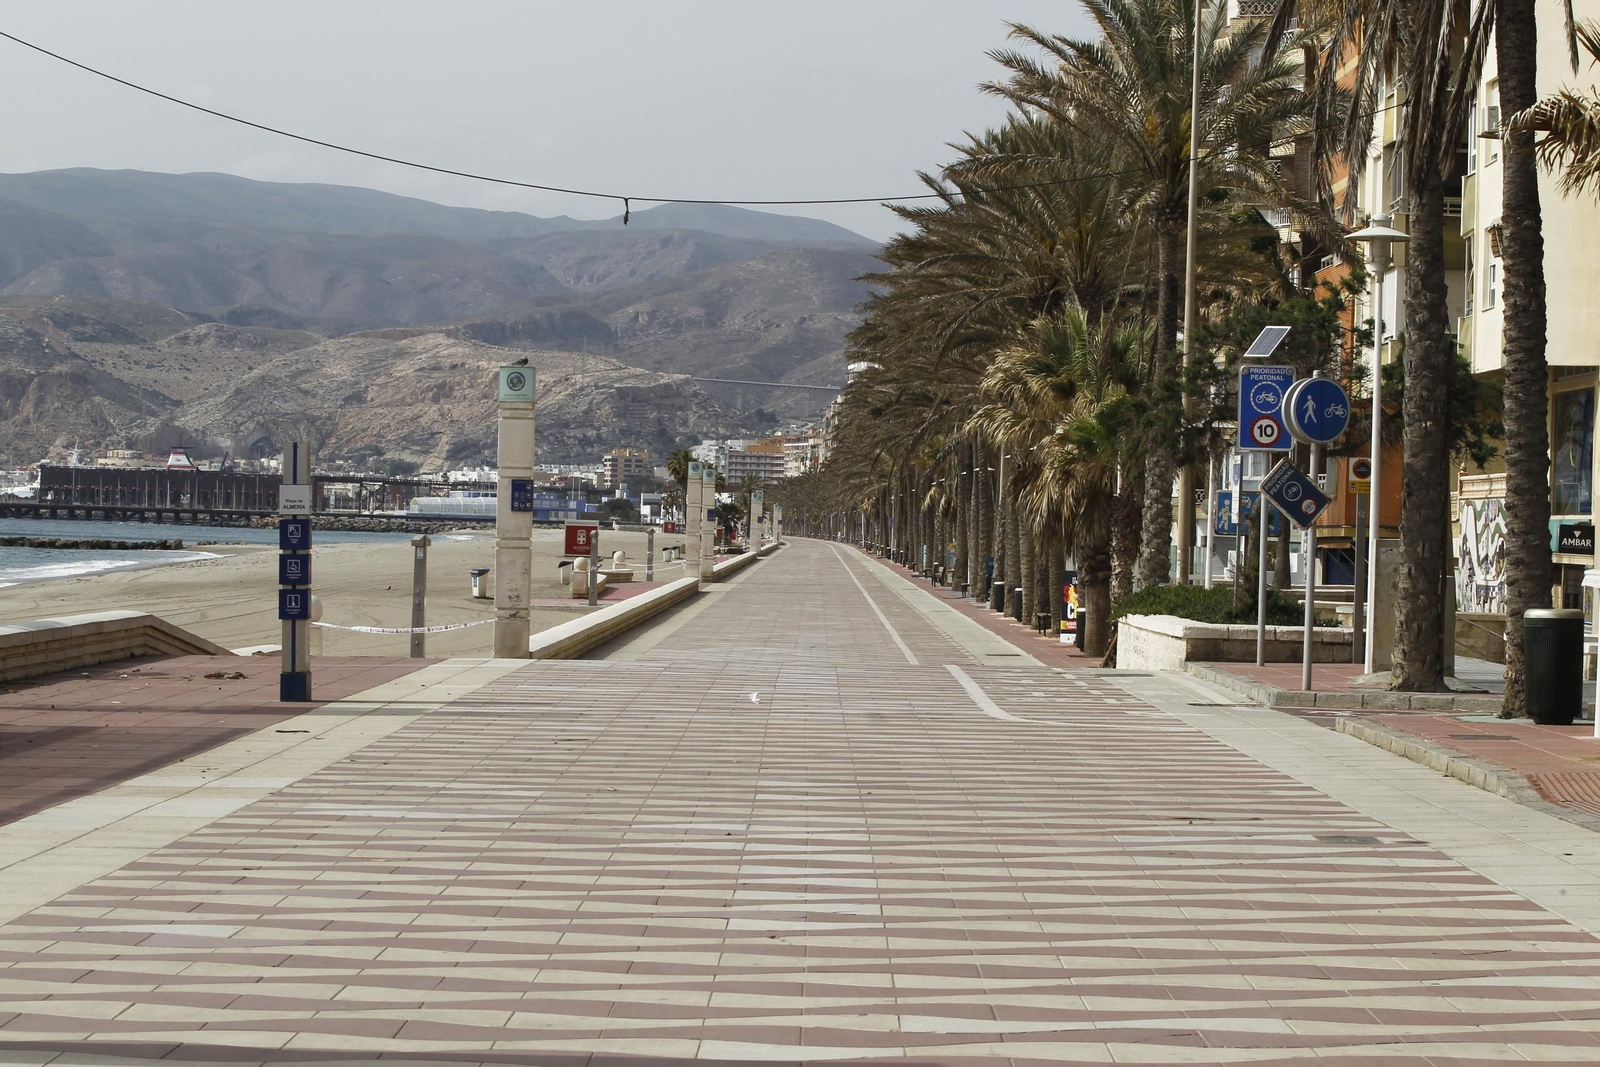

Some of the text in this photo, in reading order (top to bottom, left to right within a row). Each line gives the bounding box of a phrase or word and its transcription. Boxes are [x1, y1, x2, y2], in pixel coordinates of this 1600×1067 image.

[1249, 367, 1286, 375] PRIORIDAD
[1257, 423, 1275, 438] 10
[1264, 462, 1290, 491] PRIORIDAD
[1269, 468, 1295, 496] PEATONAL
[1561, 537, 1592, 547] AMBAR
